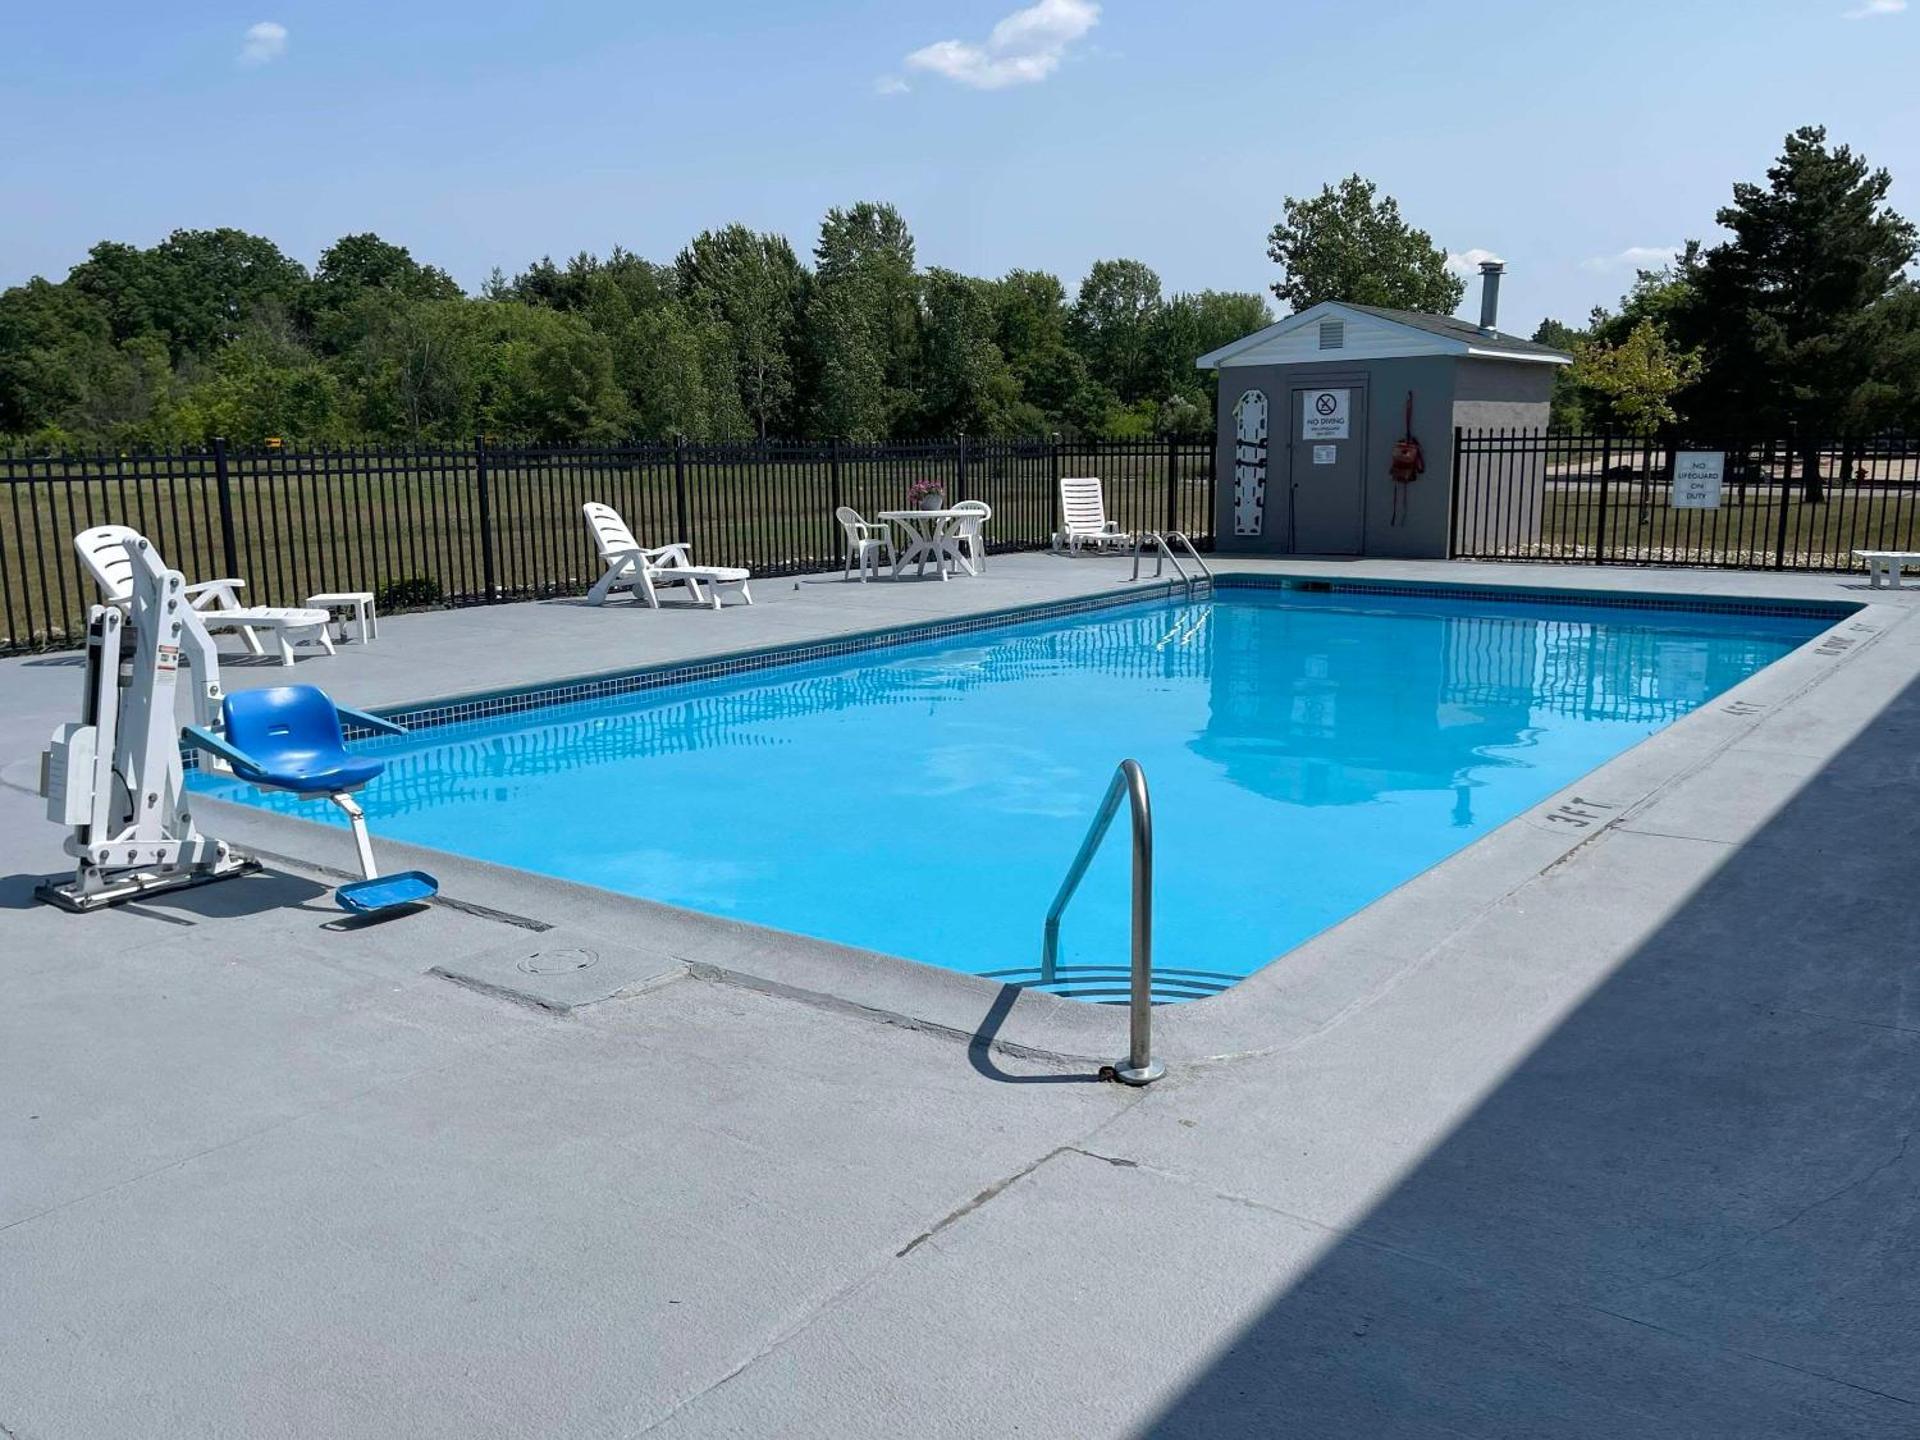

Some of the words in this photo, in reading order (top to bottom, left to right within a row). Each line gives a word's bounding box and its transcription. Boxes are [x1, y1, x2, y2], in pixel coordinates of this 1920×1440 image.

[1307, 418, 1319, 426] NO
[1692, 462, 1706, 470] NO
[1678, 472, 1719, 480] LIFEGUARD
[1686, 492, 1706, 500] DUTY
[1545, 796, 1613, 828] 3FT
